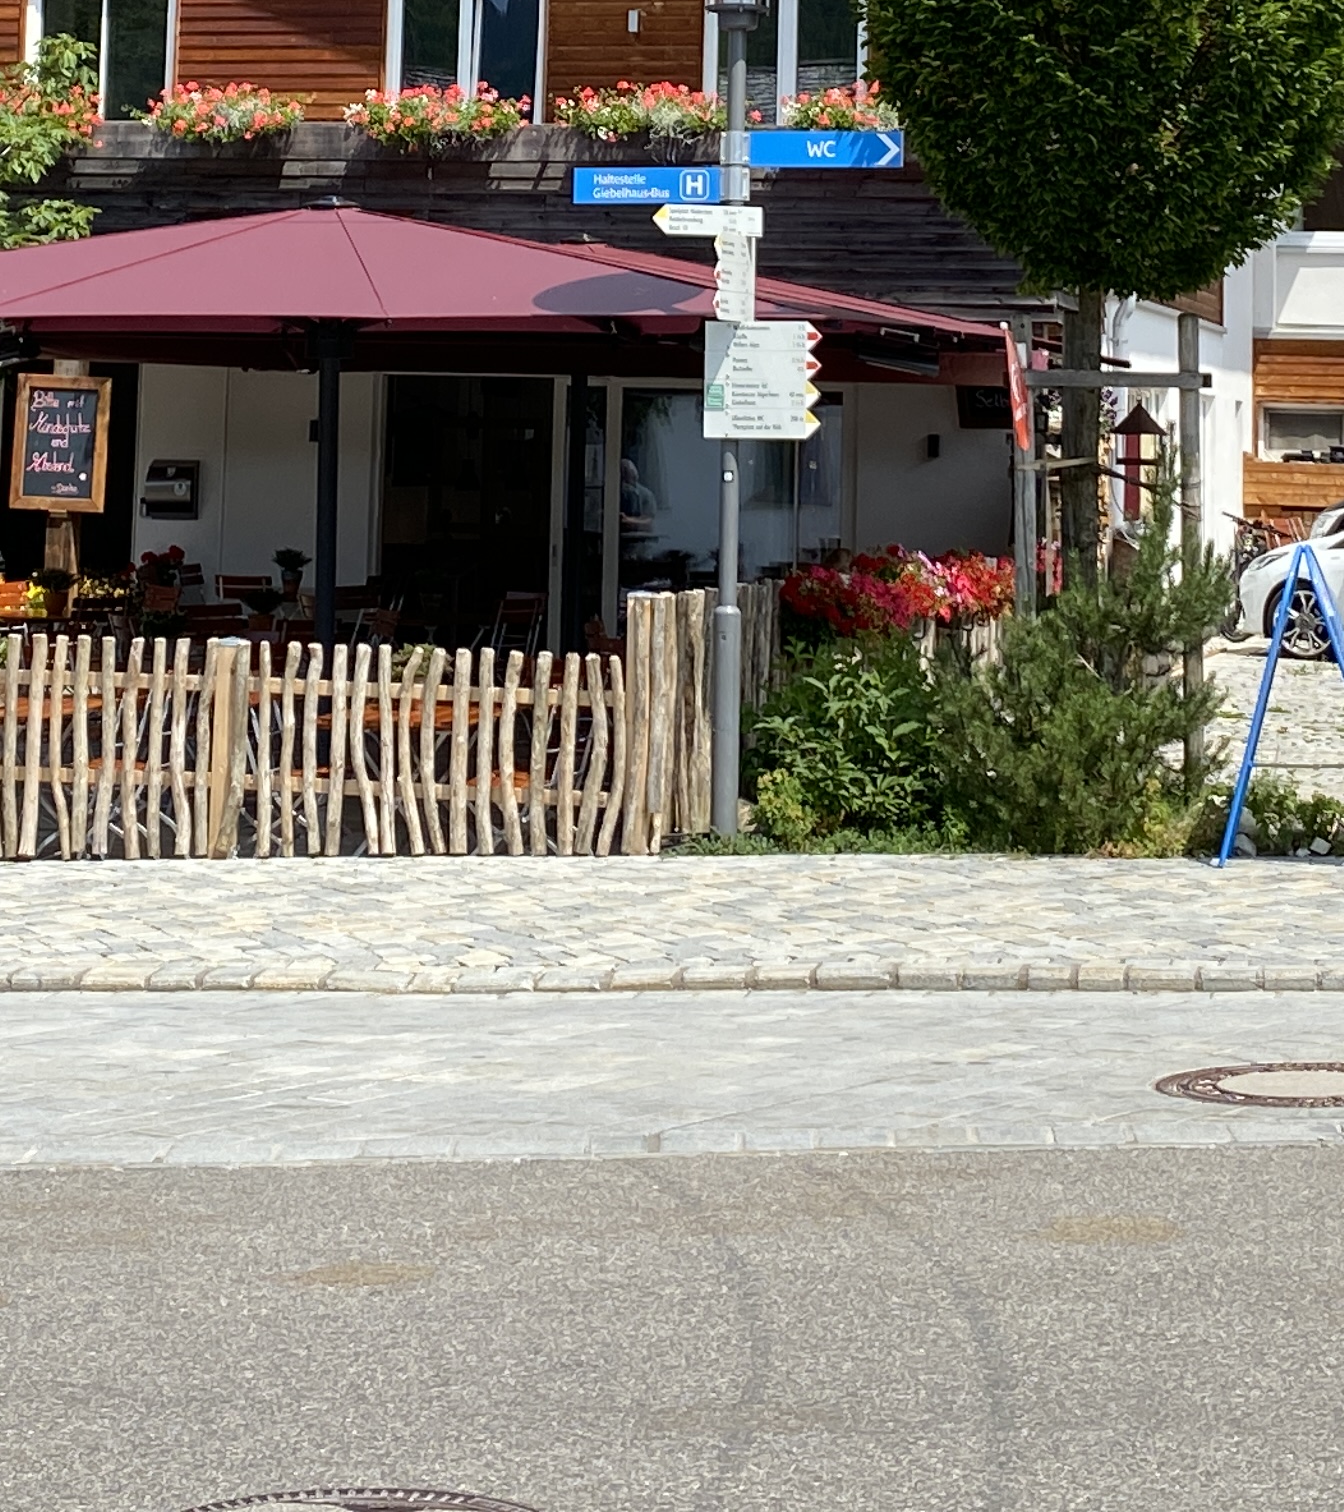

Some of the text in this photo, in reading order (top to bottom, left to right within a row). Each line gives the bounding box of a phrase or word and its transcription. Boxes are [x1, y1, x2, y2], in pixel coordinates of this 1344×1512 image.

[806, 140, 837, 158] WC
[593, 173, 704, 195] Haltestelle H
